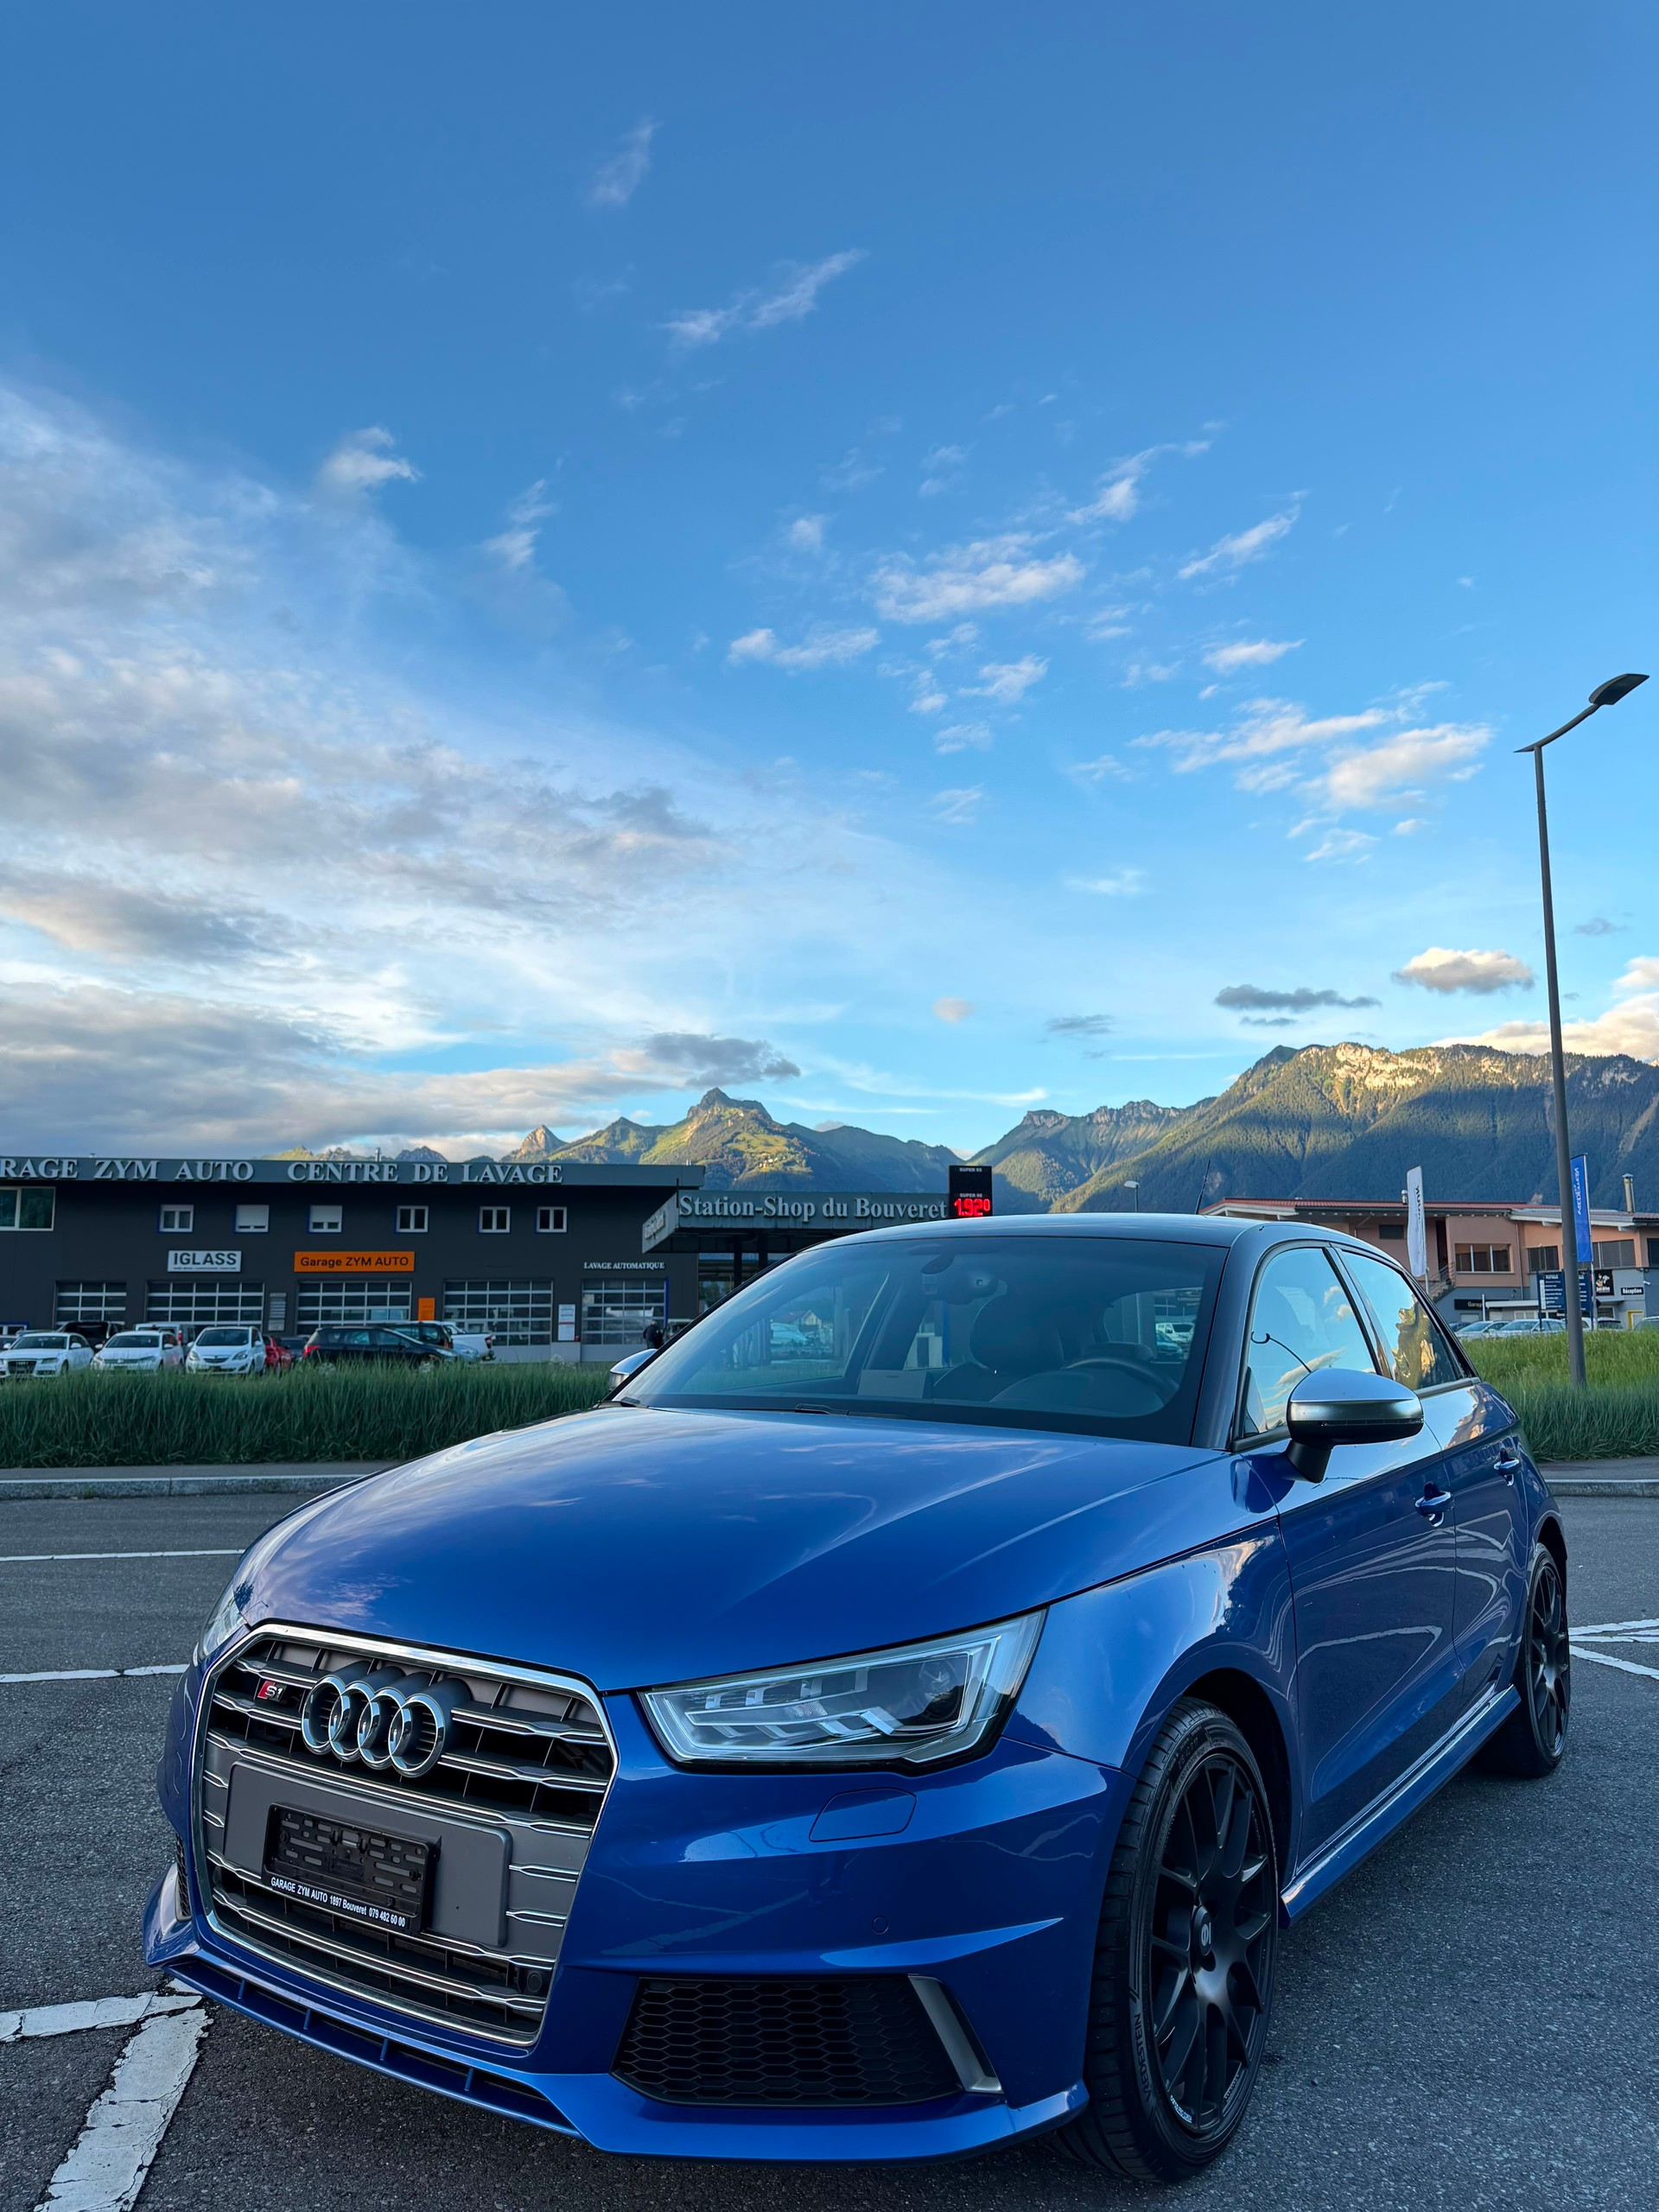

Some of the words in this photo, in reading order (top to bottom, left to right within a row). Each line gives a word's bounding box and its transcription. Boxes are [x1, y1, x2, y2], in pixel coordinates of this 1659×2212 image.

[0, 1158, 79, 1179] RAGE
[93, 1160, 159, 1180] ZYM
[175, 1160, 254, 1182] AUTO
[287, 1162, 398, 1183] CENTRE
[413, 1163, 448, 1184] DE
[462, 1164, 563, 1185] LAVAGE
[678, 1195, 816, 1223] Station-Shop
[822, 1198, 848, 1217] du
[855, 1198, 948, 1219] Bouveret
[174, 1253, 237, 1265] IGLASS
[300, 1256, 342, 1268] Garage
[345, 1257, 372, 1266] ZYM
[374, 1256, 409, 1266] AUTO
[270, 1877, 296, 1892] GARAGE
[296, 1885, 310, 1897] ZYM
[311, 1890, 327, 1903] AUTO
[329, 1896, 342, 1908] 1897
[342, 1901, 367, 1915] Bouveret
[368, 1909, 379, 1918] 079
[379, 1912, 390, 1923] 482
[390, 1916, 398, 1925] 60
[397, 1917, 406, 1928] 00
[1133, 2012, 1152, 2102] VREDESTEIN
